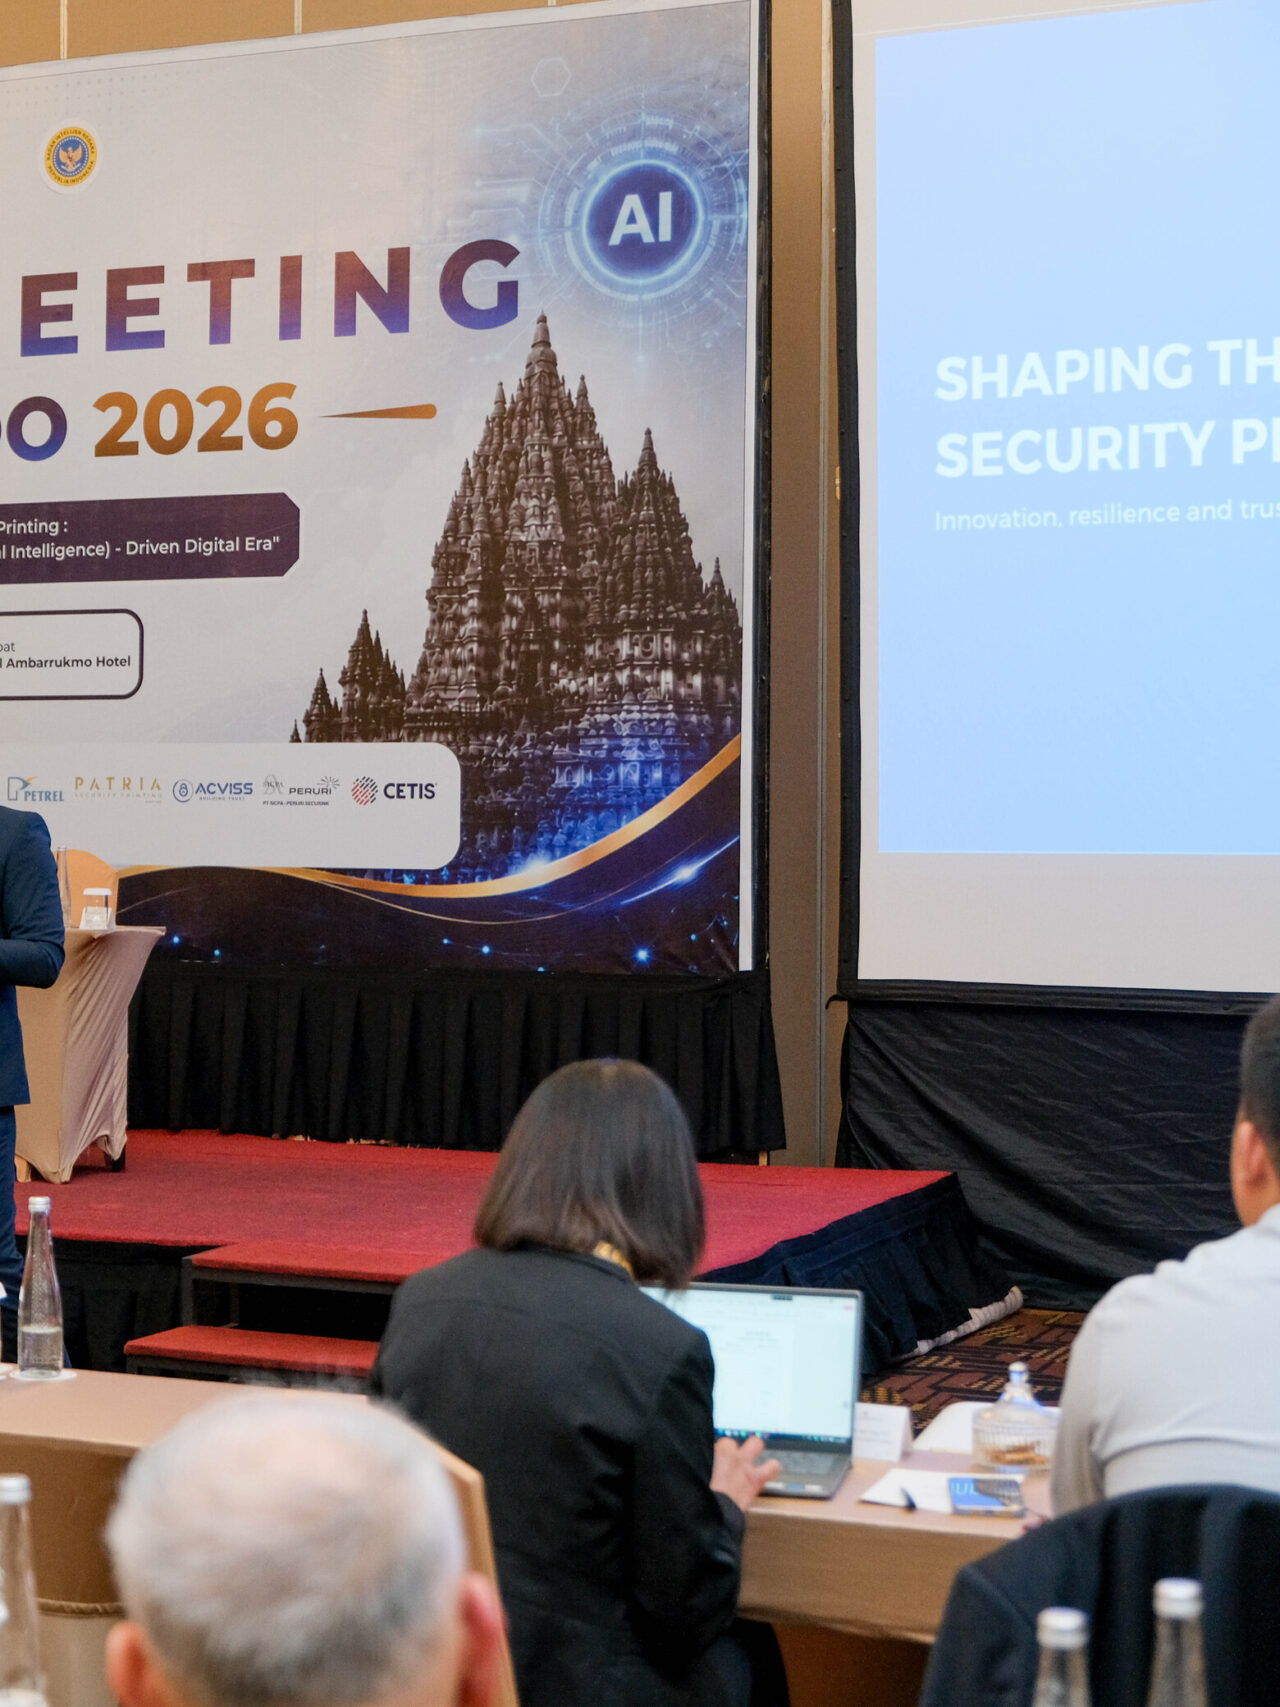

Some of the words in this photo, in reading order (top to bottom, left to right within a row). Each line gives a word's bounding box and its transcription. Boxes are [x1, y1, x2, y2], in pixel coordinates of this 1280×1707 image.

[608, 191, 672, 246] AI
[936, 343, 1192, 401] SHAPING
[93, 383, 298, 457] 2026
[936, 420, 1216, 478] SECURITY
[1232, 417, 1280, 464] P
[936, 507, 1062, 530] Innovation,
[1069, 503, 1180, 525] resilience
[1186, 498, 1232, 522] and
[11, 541, 110, 561] Intelligence)
[127, 539, 179, 555] Driven
[185, 536, 239, 556] Digital
[6, 657, 92, 668] Ambarrukmo
[97, 656, 130, 667] Hotel
[24, 791, 64, 801] PETREL
[75, 777, 160, 790] PATRIA
[195, 783, 253, 795] ACVISS
[384, 783, 435, 799] CETIS
